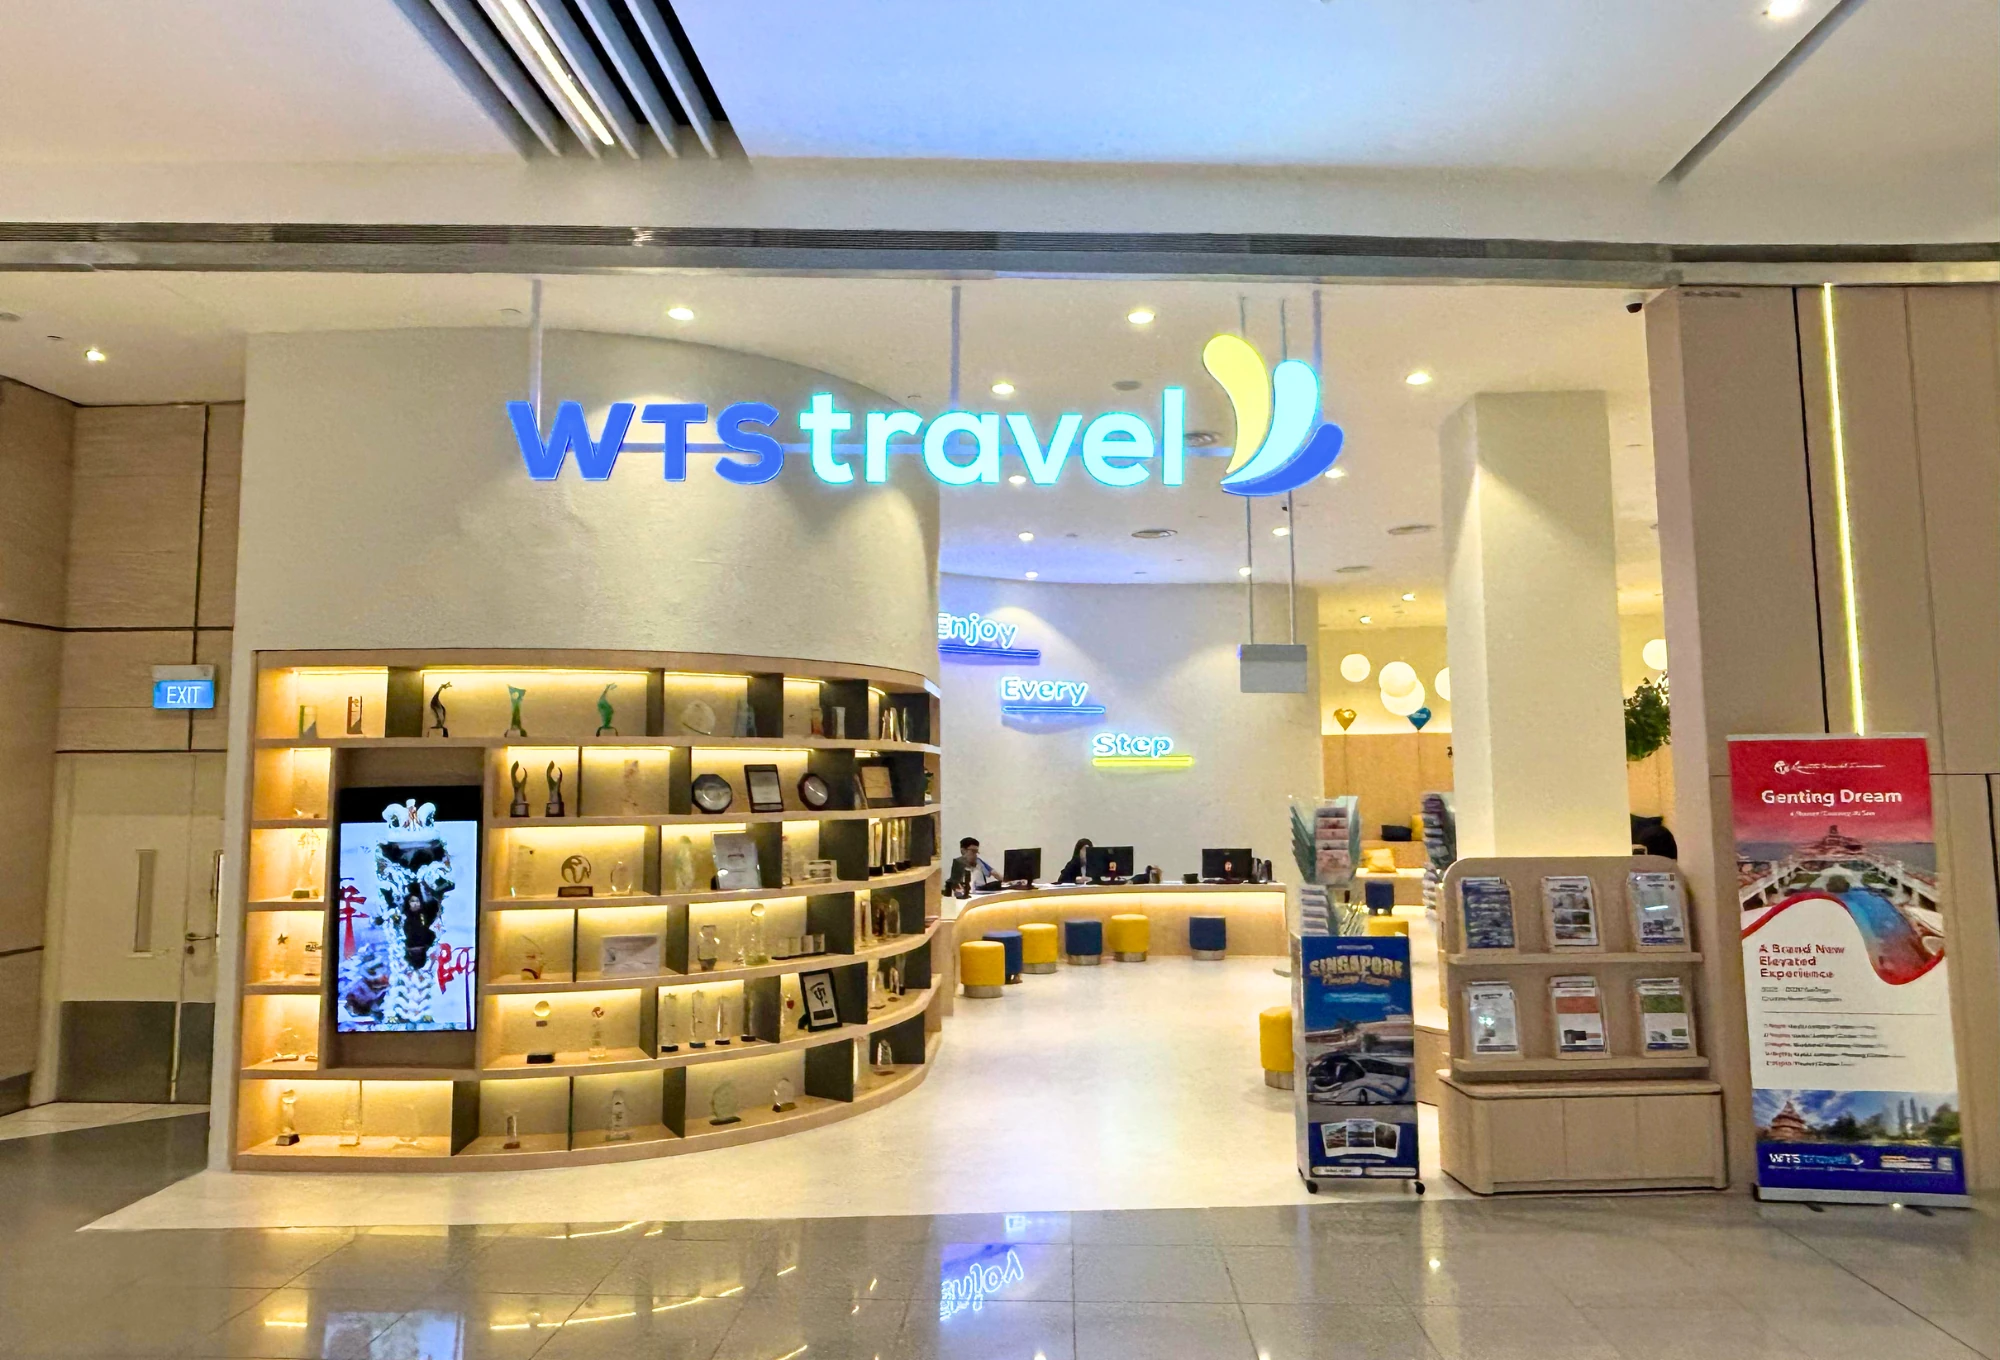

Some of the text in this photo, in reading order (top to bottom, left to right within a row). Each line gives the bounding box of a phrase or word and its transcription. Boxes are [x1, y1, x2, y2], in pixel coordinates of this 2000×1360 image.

[506, 385, 1185, 487] WTS travel
[938, 612, 1018, 649] Enjoy
[166, 686, 202, 704] EXIT
[1000, 676, 1088, 706] Every
[1092, 732, 1174, 757] Step
[1761, 789, 1903, 807] Genting Dream
[1759, 944, 1845, 954] A Brand New
[1309, 955, 1403, 977] SINGAPORE
[1760, 956, 1817, 967] Elevated
[1760, 968, 1834, 980] Experience
[1768, 1153, 1800, 1164] WTS
